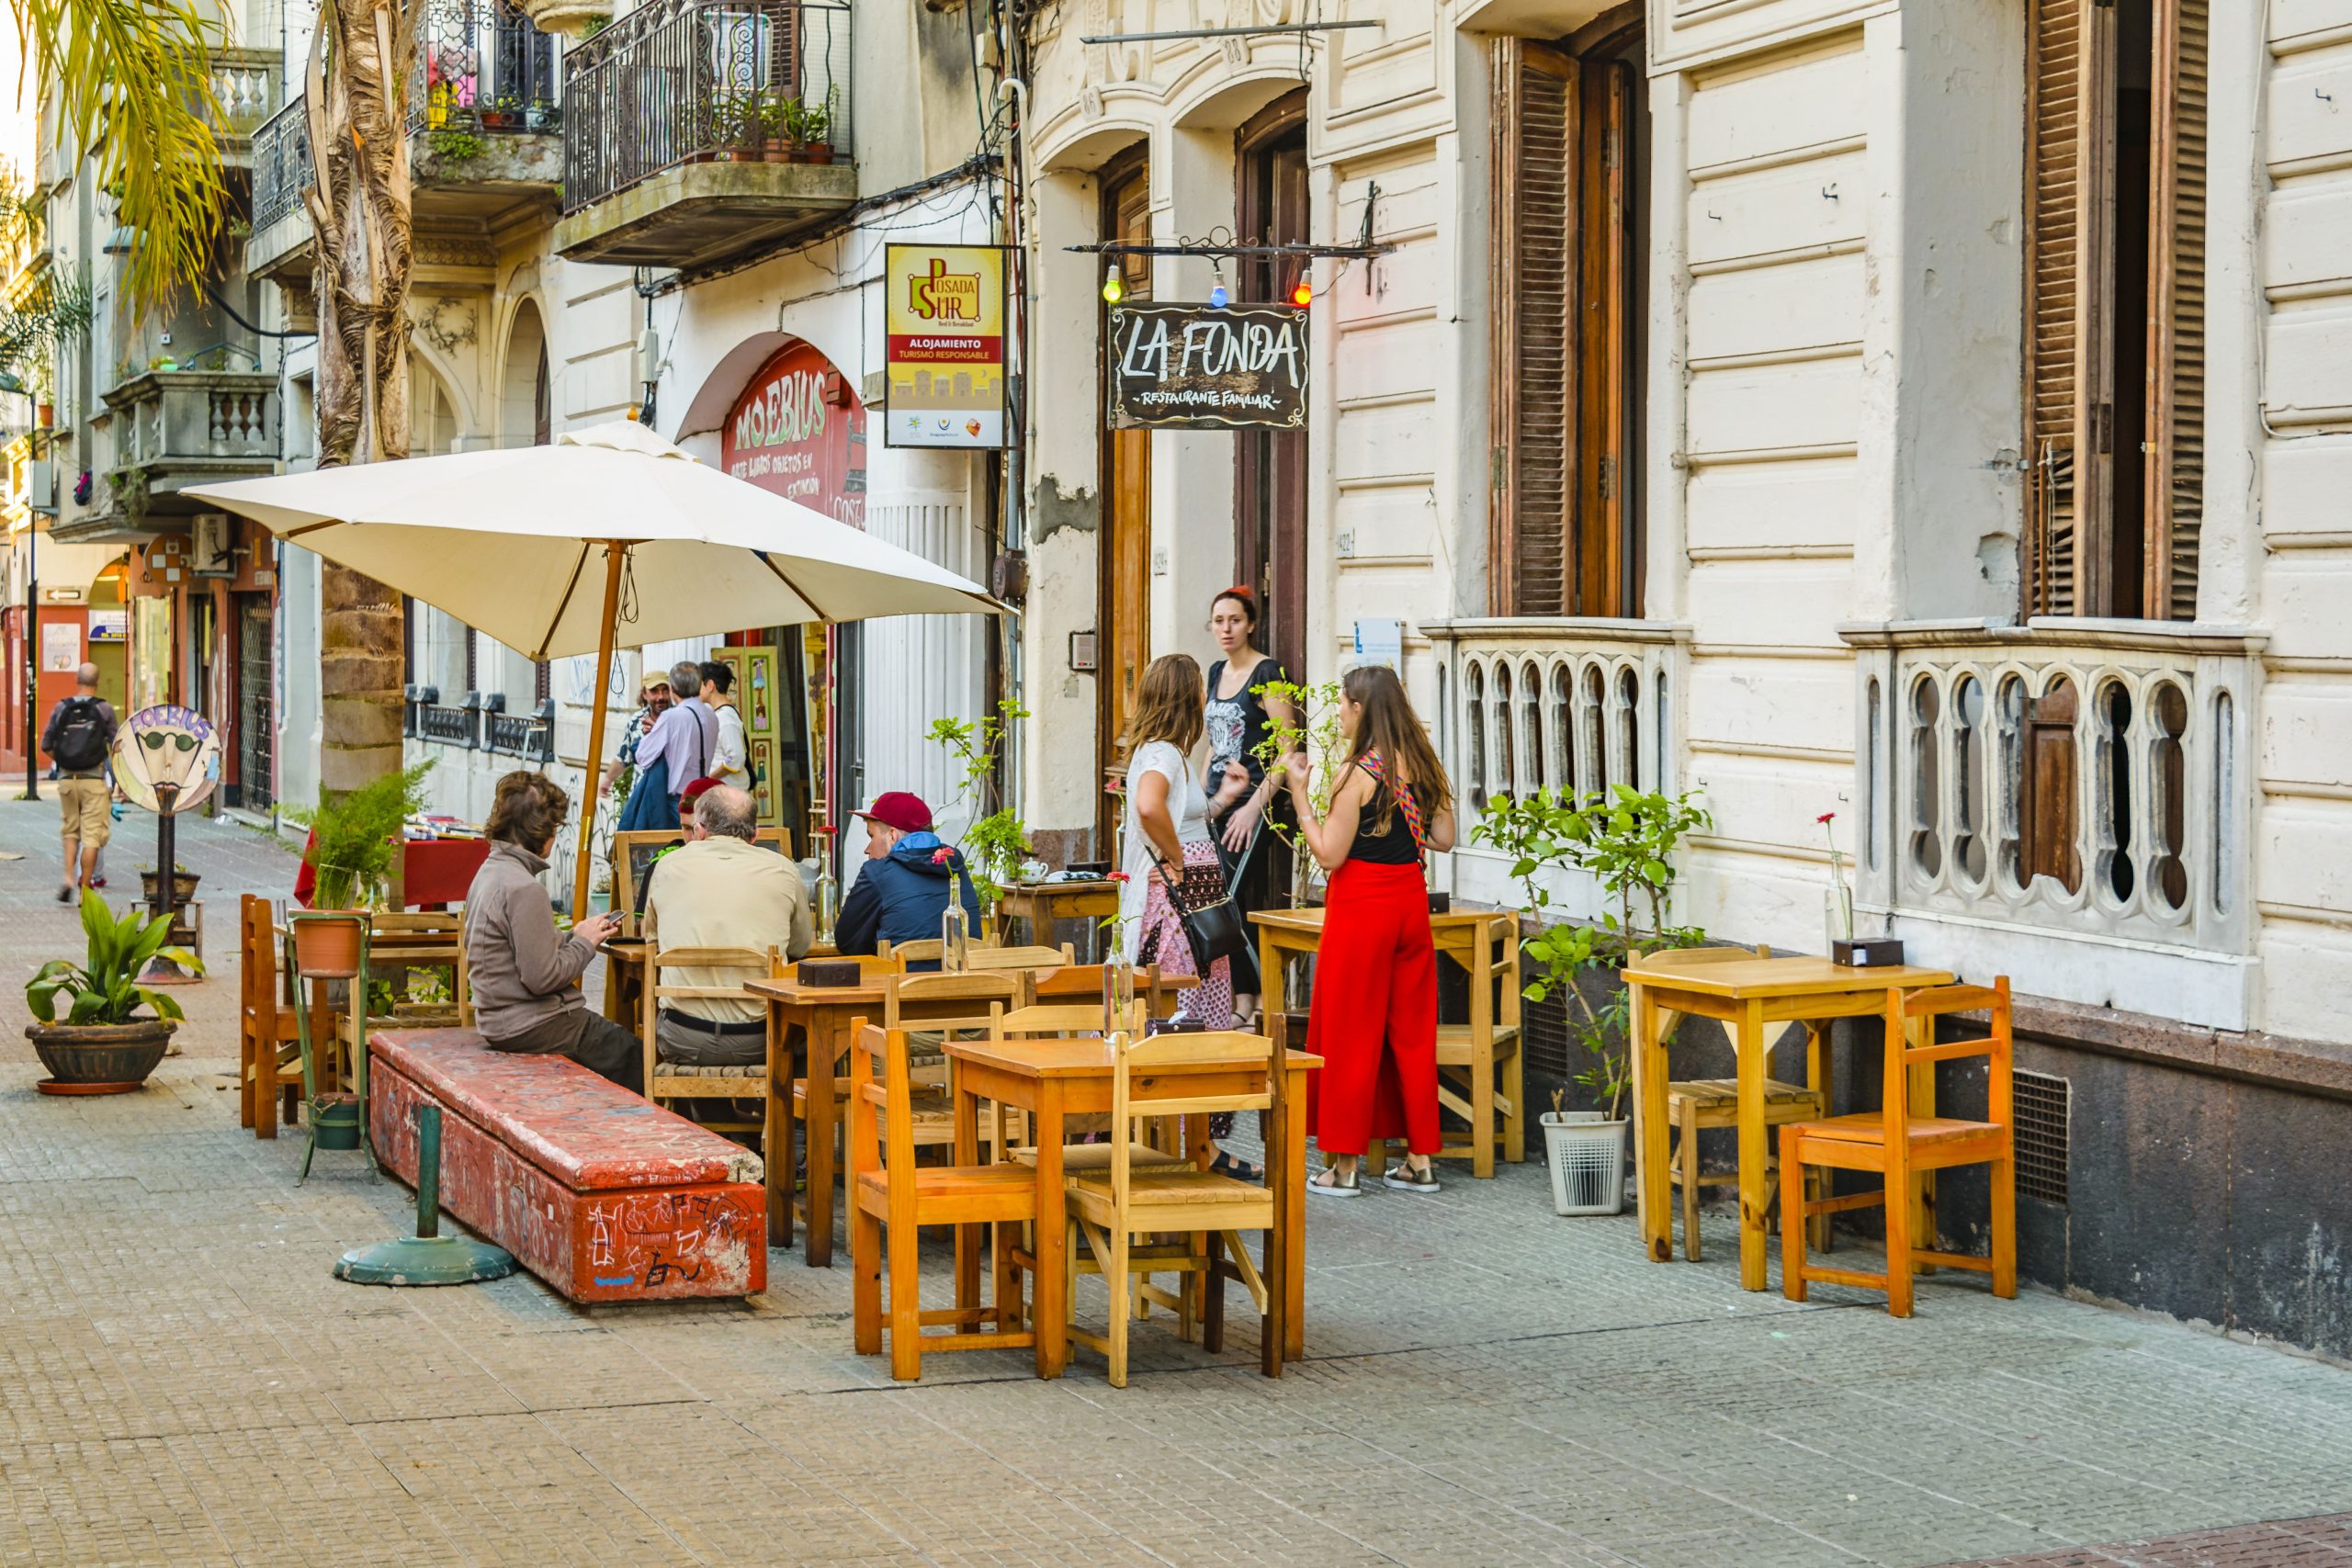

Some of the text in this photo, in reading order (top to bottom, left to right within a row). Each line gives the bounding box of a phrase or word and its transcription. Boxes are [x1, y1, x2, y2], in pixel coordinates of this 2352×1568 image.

[910, 339, 981, 350] ALOJAMIENTO
[935, 351, 989, 360] RESPONSABLE
[1122, 316, 1299, 389] LA FONDA
[735, 369, 825, 451] MOEBIUS
[1140, 389, 1276, 411] RESTAURANTE FAMILIAR
[773, 451, 802, 474] OBJETOS
